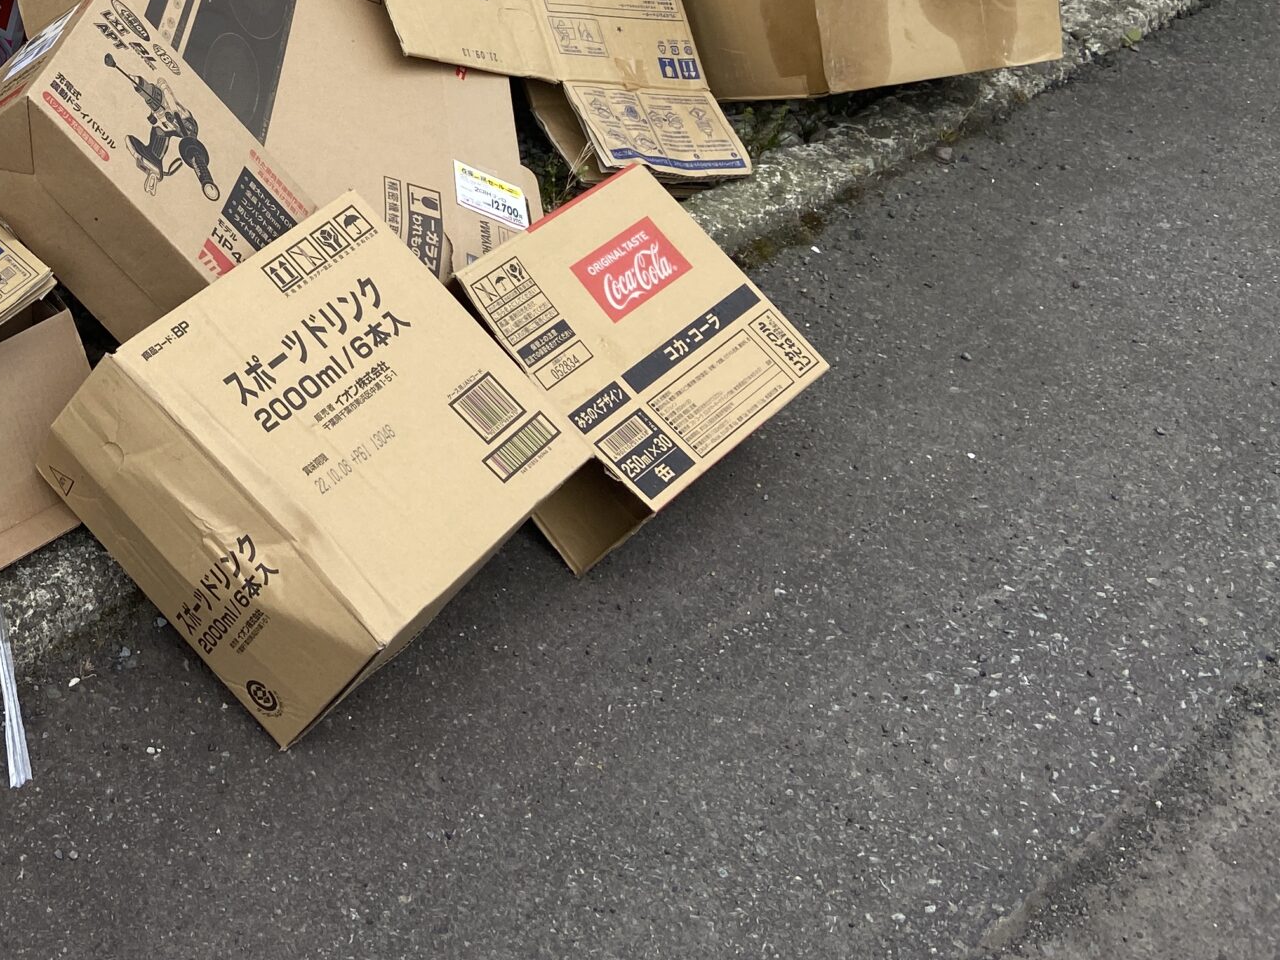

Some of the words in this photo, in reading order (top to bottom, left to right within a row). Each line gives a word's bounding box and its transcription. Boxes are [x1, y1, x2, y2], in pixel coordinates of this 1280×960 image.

[94, 23, 129, 50] APT
[55, 72, 82, 101] 充電式
[49, 80, 116, 150] 震動ドライバドリル
[211, 228, 245, 263] HP4
[218, 219, 238, 242] モデル
[587, 246, 626, 276] ORIGINAL
[622, 230, 649, 254] TASTE
[603, 241, 673, 310] Coca-Cola
[222, 277, 382, 407] スポーツドリンク
[662, 312, 720, 362] コカ・コーラ
[758, 321, 804, 372] リサイクル
[254, 310, 412, 433] 2000ml/6本入
[334, 360, 391, 406] イオン株式会社
[550, 356, 581, 381] 052834
[573, 388, 623, 429] みちのくデザイン
[655, 464, 677, 483] 缶
[176, 534, 256, 635] スポーツドリンク
[198, 563, 279, 655] 2000ml/6本入
